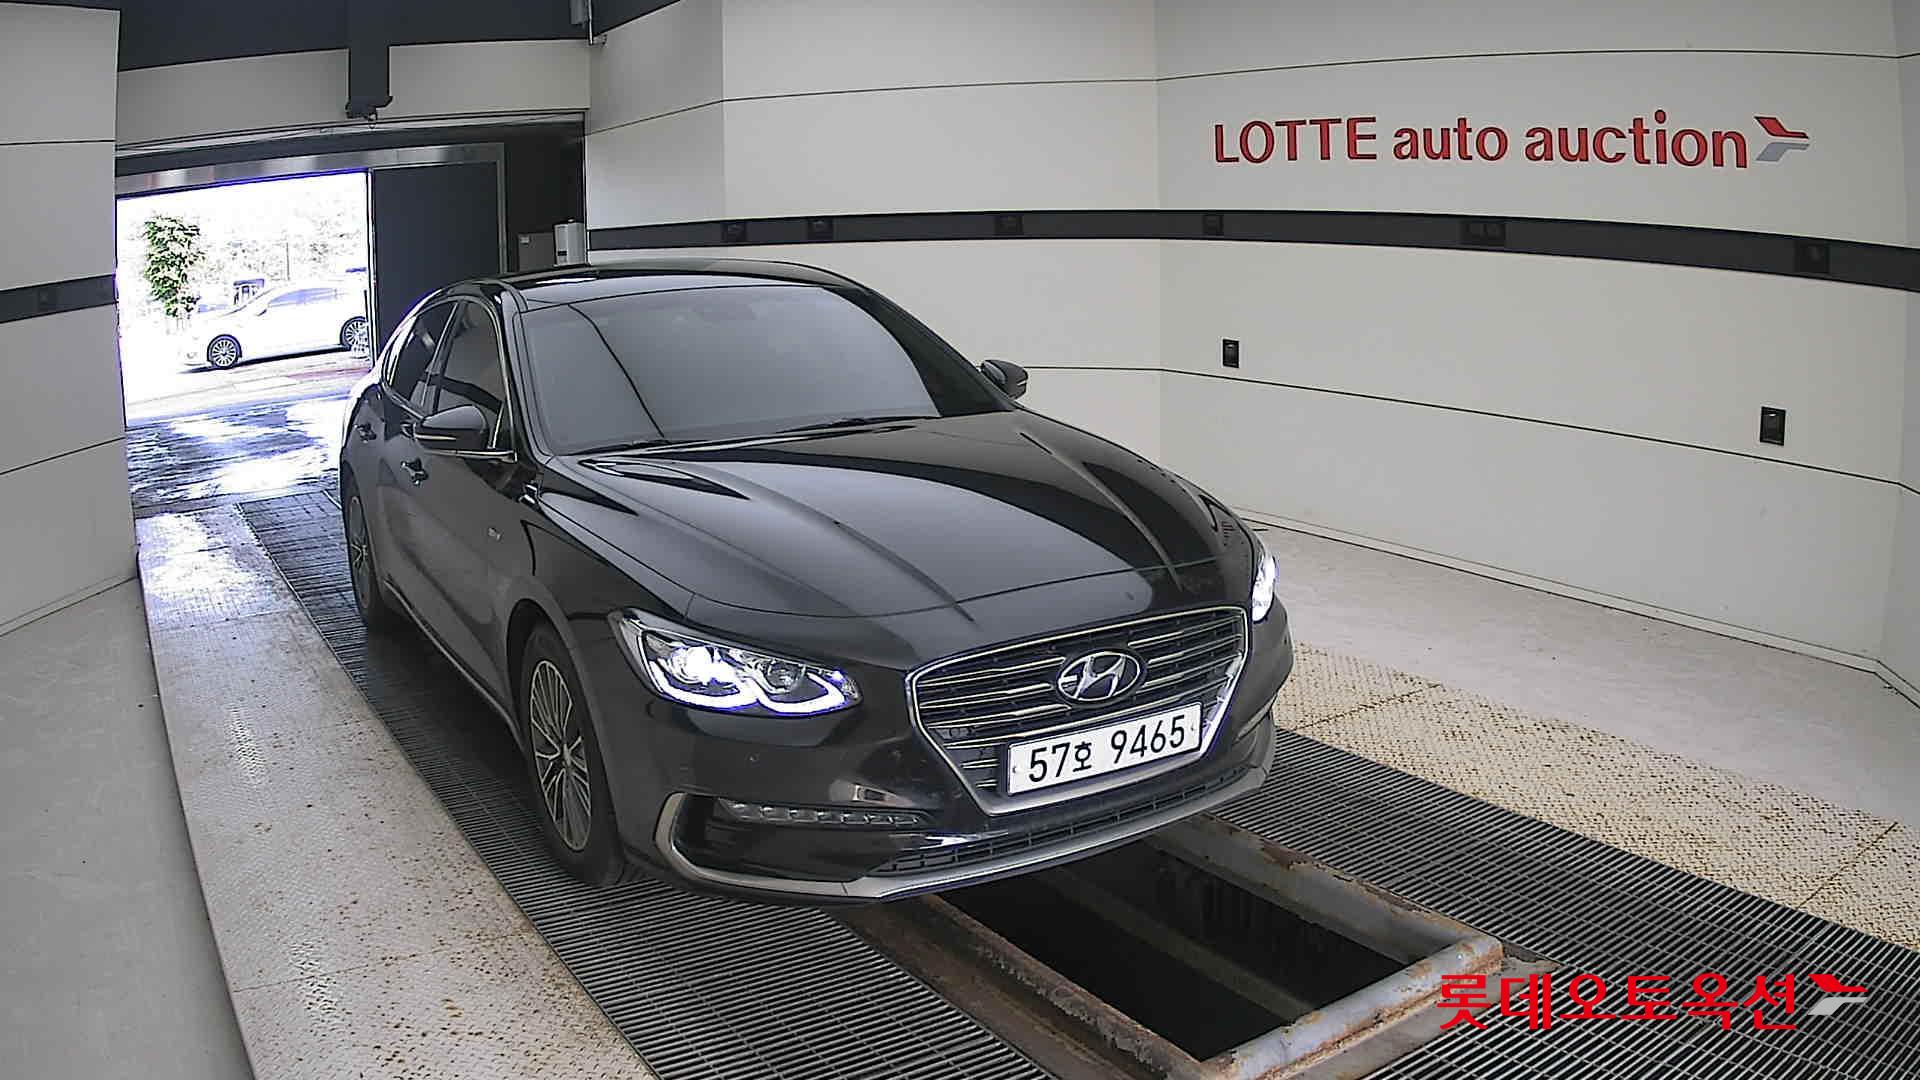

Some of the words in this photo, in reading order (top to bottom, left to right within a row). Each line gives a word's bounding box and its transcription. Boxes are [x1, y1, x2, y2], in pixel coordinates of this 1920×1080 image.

[1215, 116, 1377, 163] LOTTE
[1393, 117, 1508, 161] auto
[1525, 110, 1748, 168] auction
[1028, 741, 1092, 783] 57호
[1110, 715, 1185, 764] 9465
